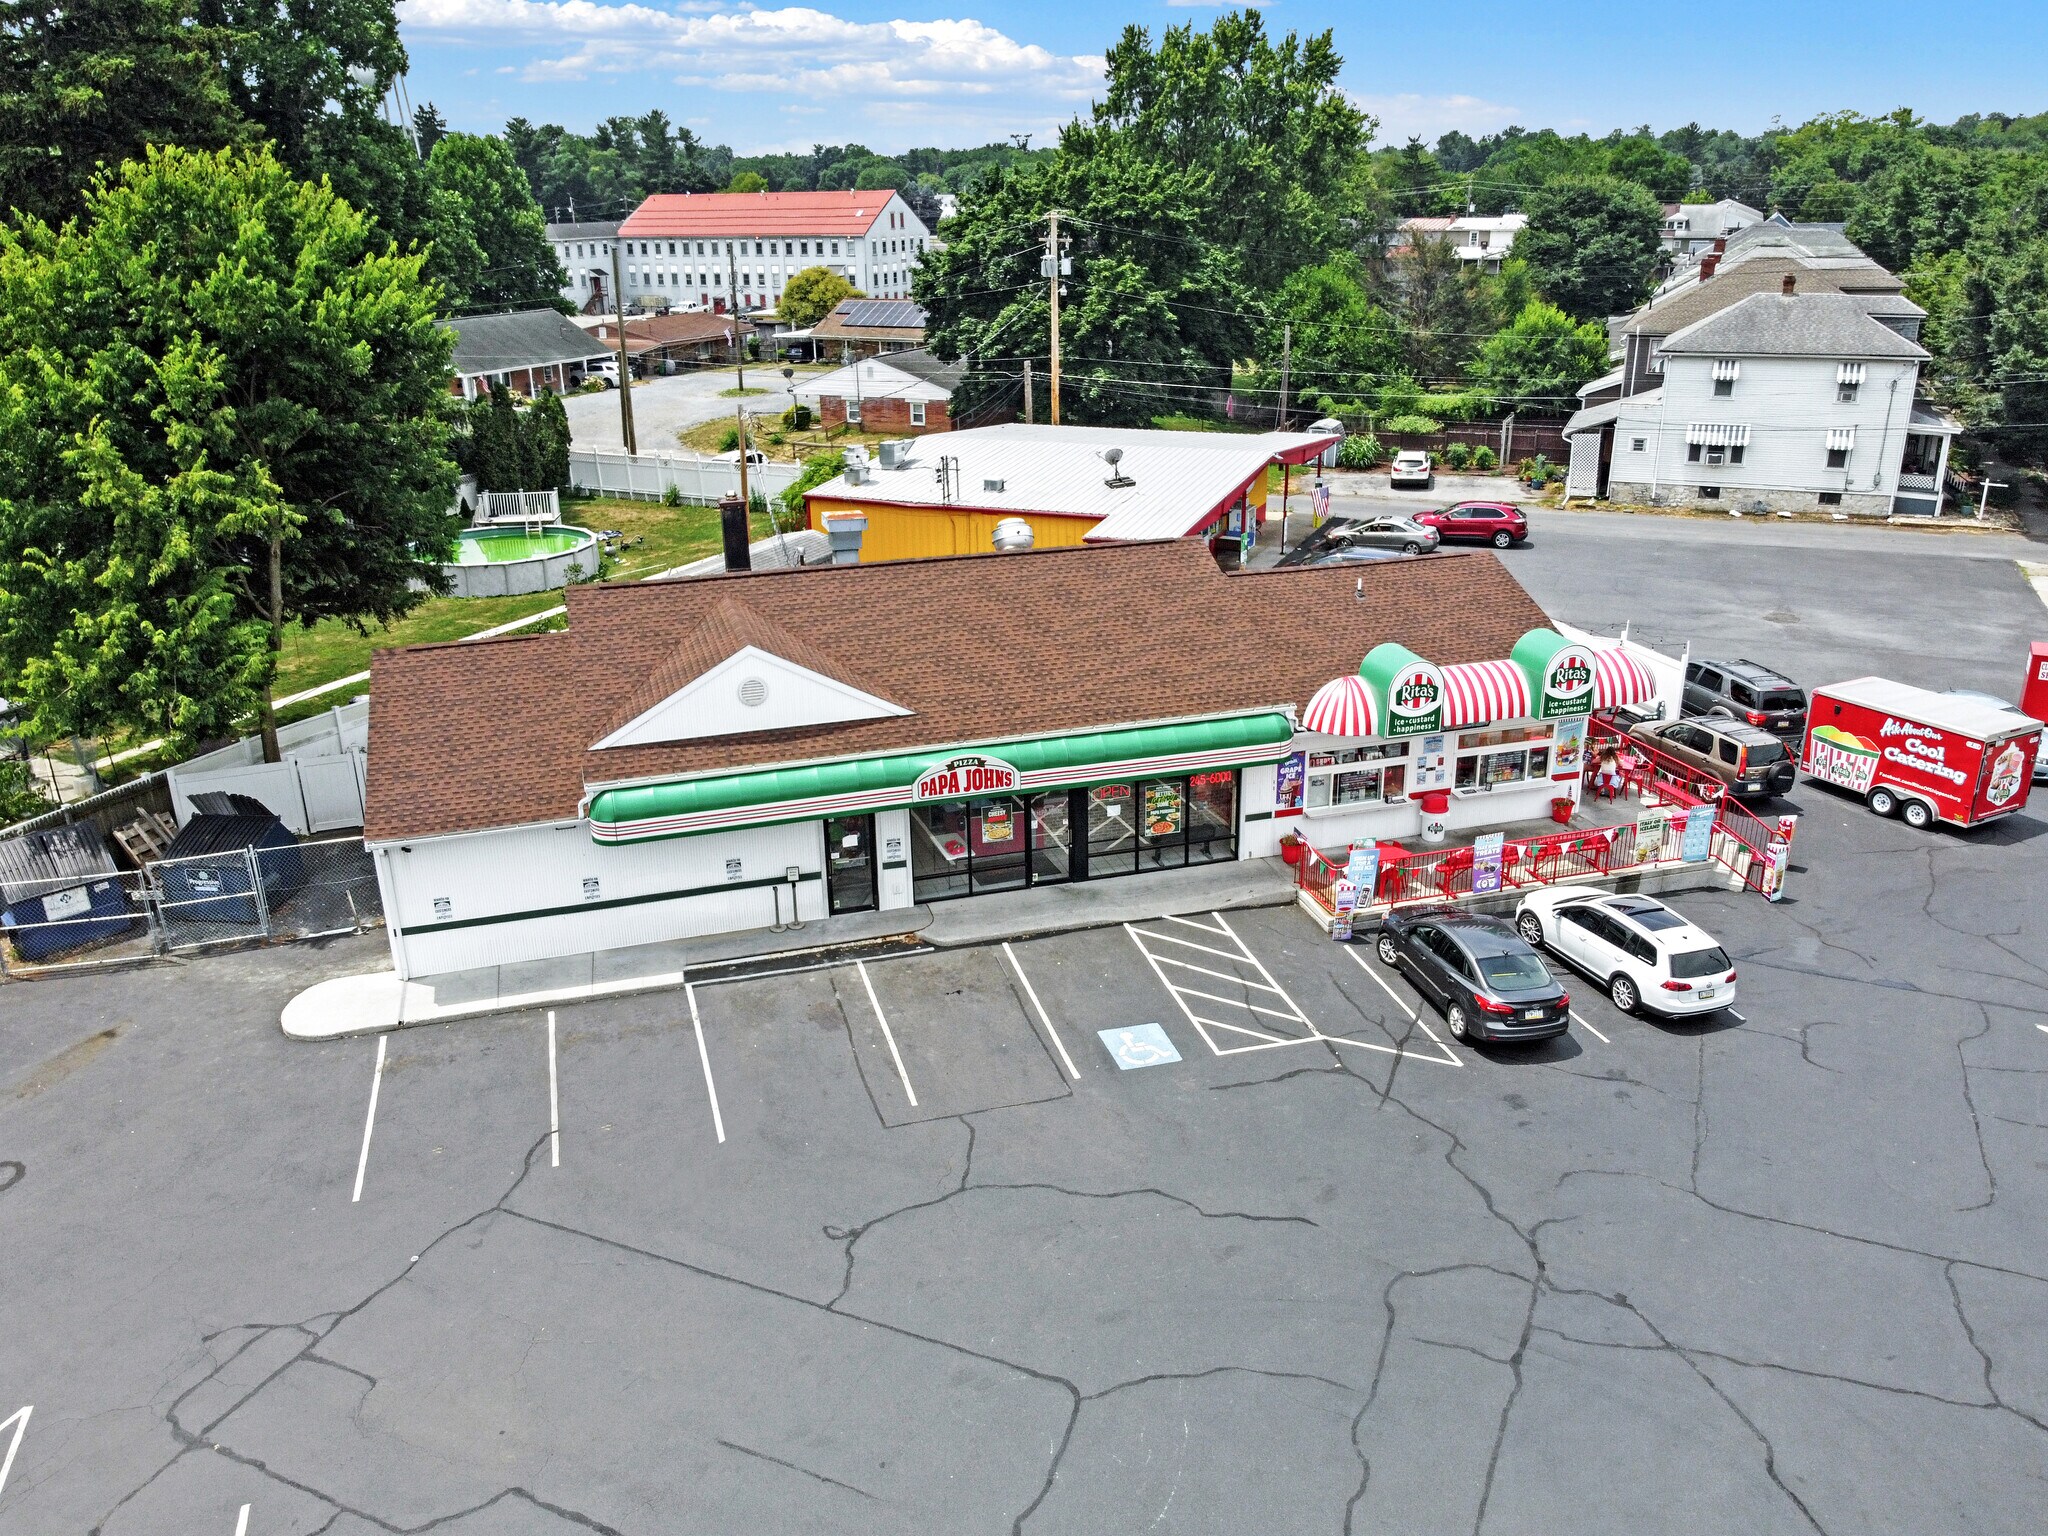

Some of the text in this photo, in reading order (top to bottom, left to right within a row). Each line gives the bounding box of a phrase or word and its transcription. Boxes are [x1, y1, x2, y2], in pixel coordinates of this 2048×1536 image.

[1556, 667, 1587, 683] Rita's
[1402, 684, 1434, 700] Rita's
[1562, 697, 1587, 706] custard
[1550, 706, 1584, 715] happiness
[1409, 715, 1435, 724] custard
[1397, 724, 1432, 733] happiness
[1880, 717, 1901, 737] Ask
[1924, 727, 1943, 741] Our
[1905, 738, 1945, 761] Cool
[953, 758, 979, 768] PIZZA
[1280, 766, 1302, 774] GRAPE
[1884, 746, 1968, 785] Catering
[921, 771, 960, 797] PAPA
[1189, 771, 1233, 787] 245-6000
[1092, 785, 1130, 800] OPEN
[1476, 848, 1500, 857] TREATS
